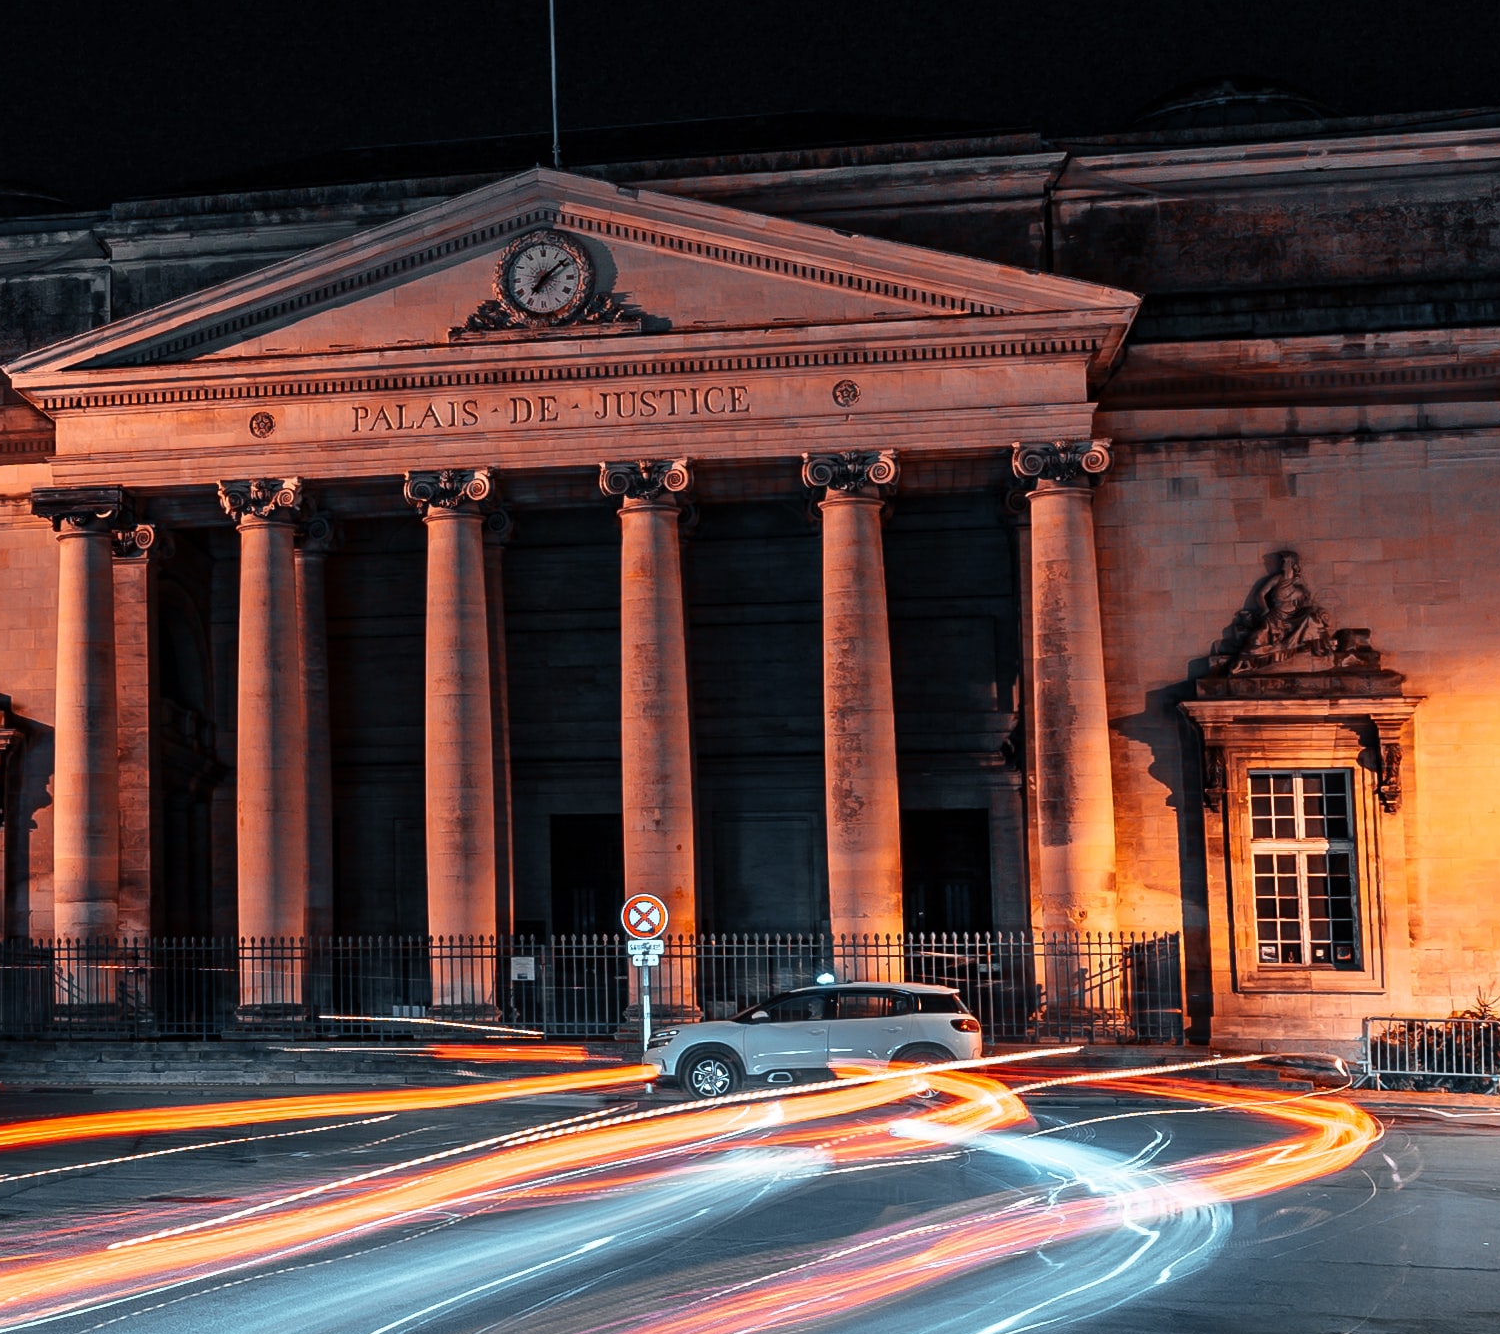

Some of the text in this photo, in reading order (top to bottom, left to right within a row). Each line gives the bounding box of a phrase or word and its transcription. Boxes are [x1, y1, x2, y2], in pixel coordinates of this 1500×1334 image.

[352, 385, 752, 432] PALAIS DE JUSTICE
